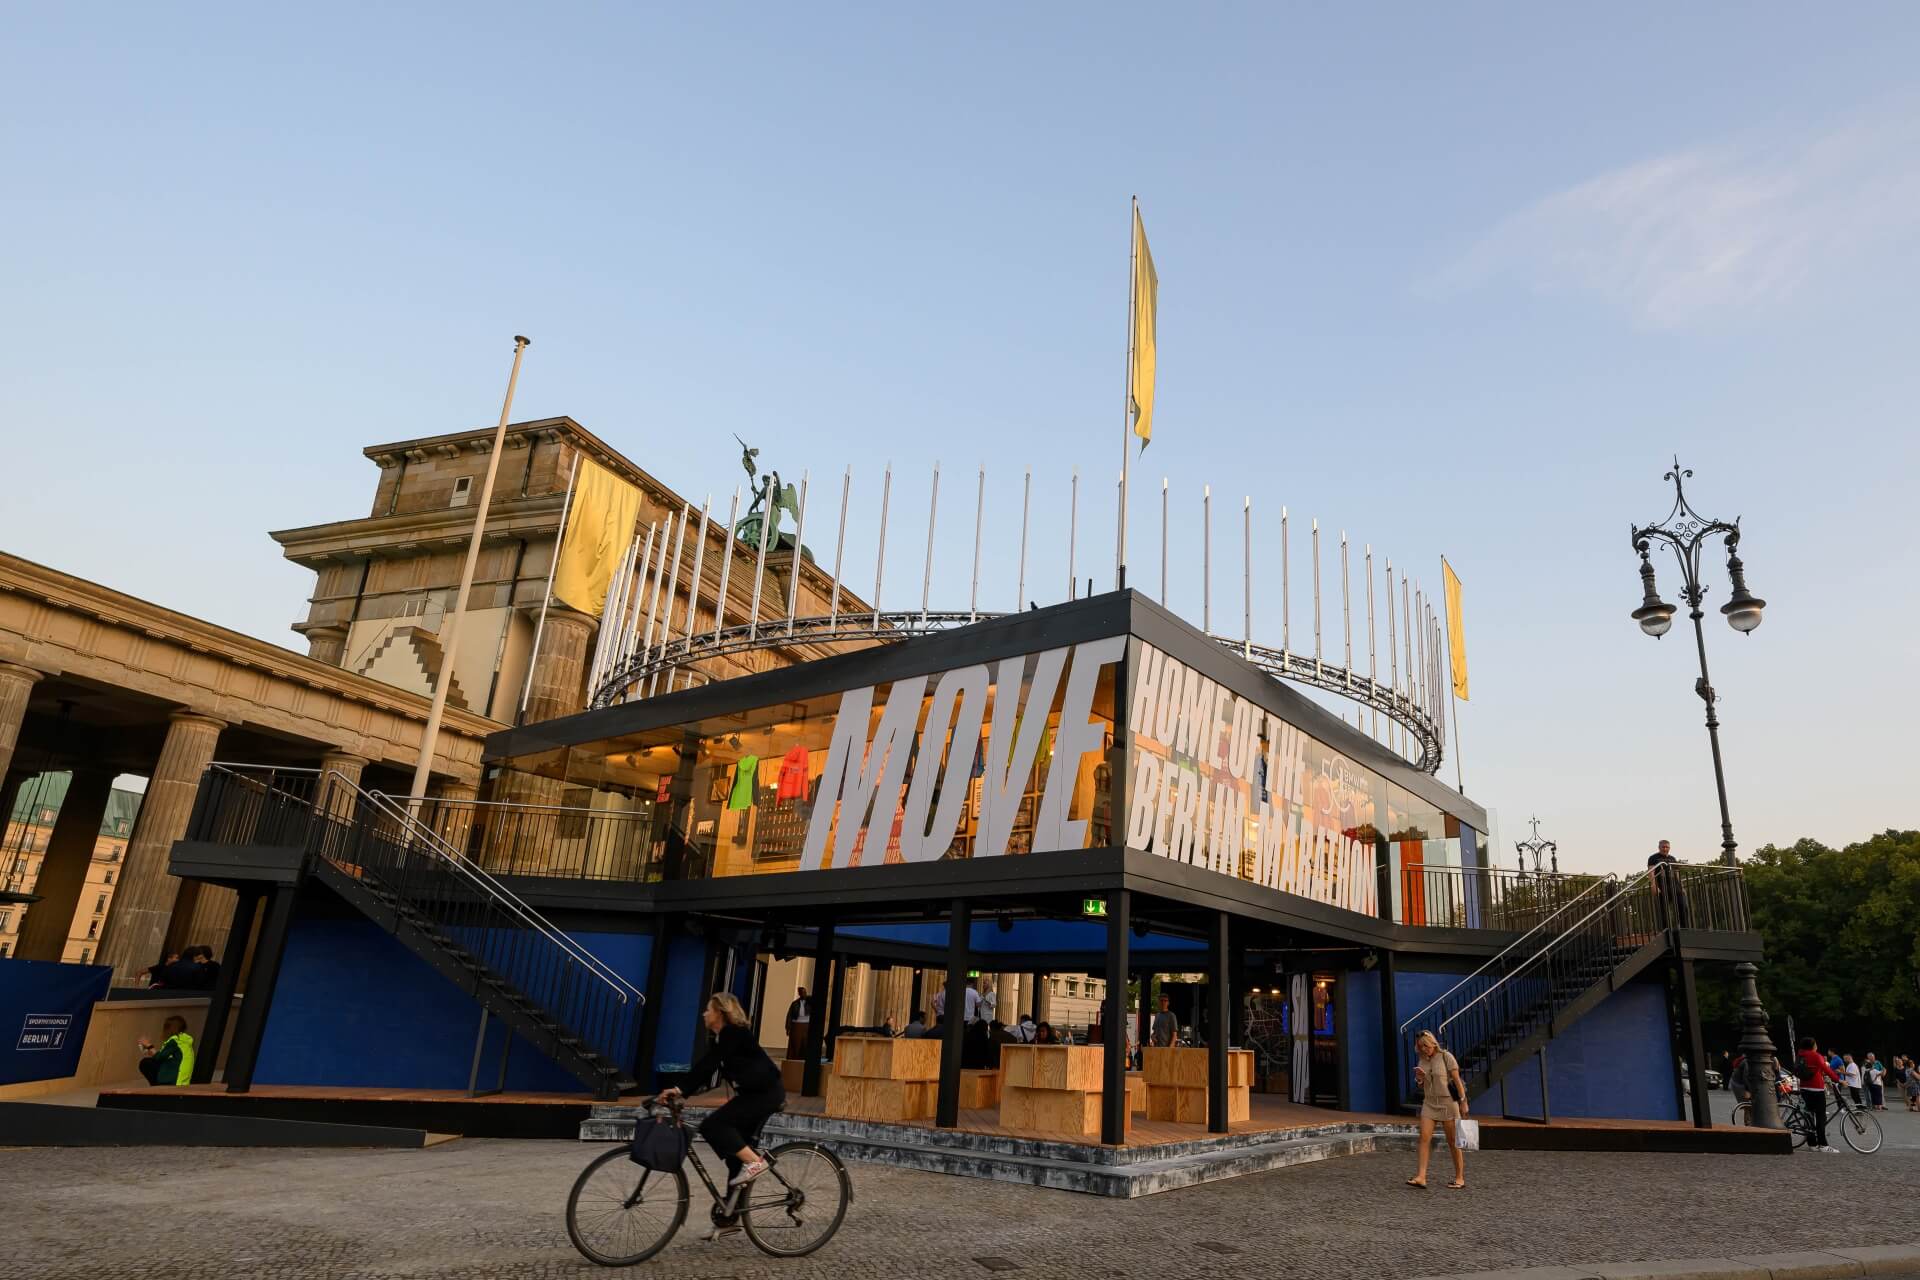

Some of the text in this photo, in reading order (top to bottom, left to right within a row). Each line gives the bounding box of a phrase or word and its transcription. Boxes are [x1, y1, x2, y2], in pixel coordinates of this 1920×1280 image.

[800, 634, 1128, 871] MOVE
[1130, 641, 1232, 769] HOME
[1229, 696, 1264, 784] OF
[1265, 711, 1310, 805] THE
[22, 1034, 49, 1043] BERLIN
